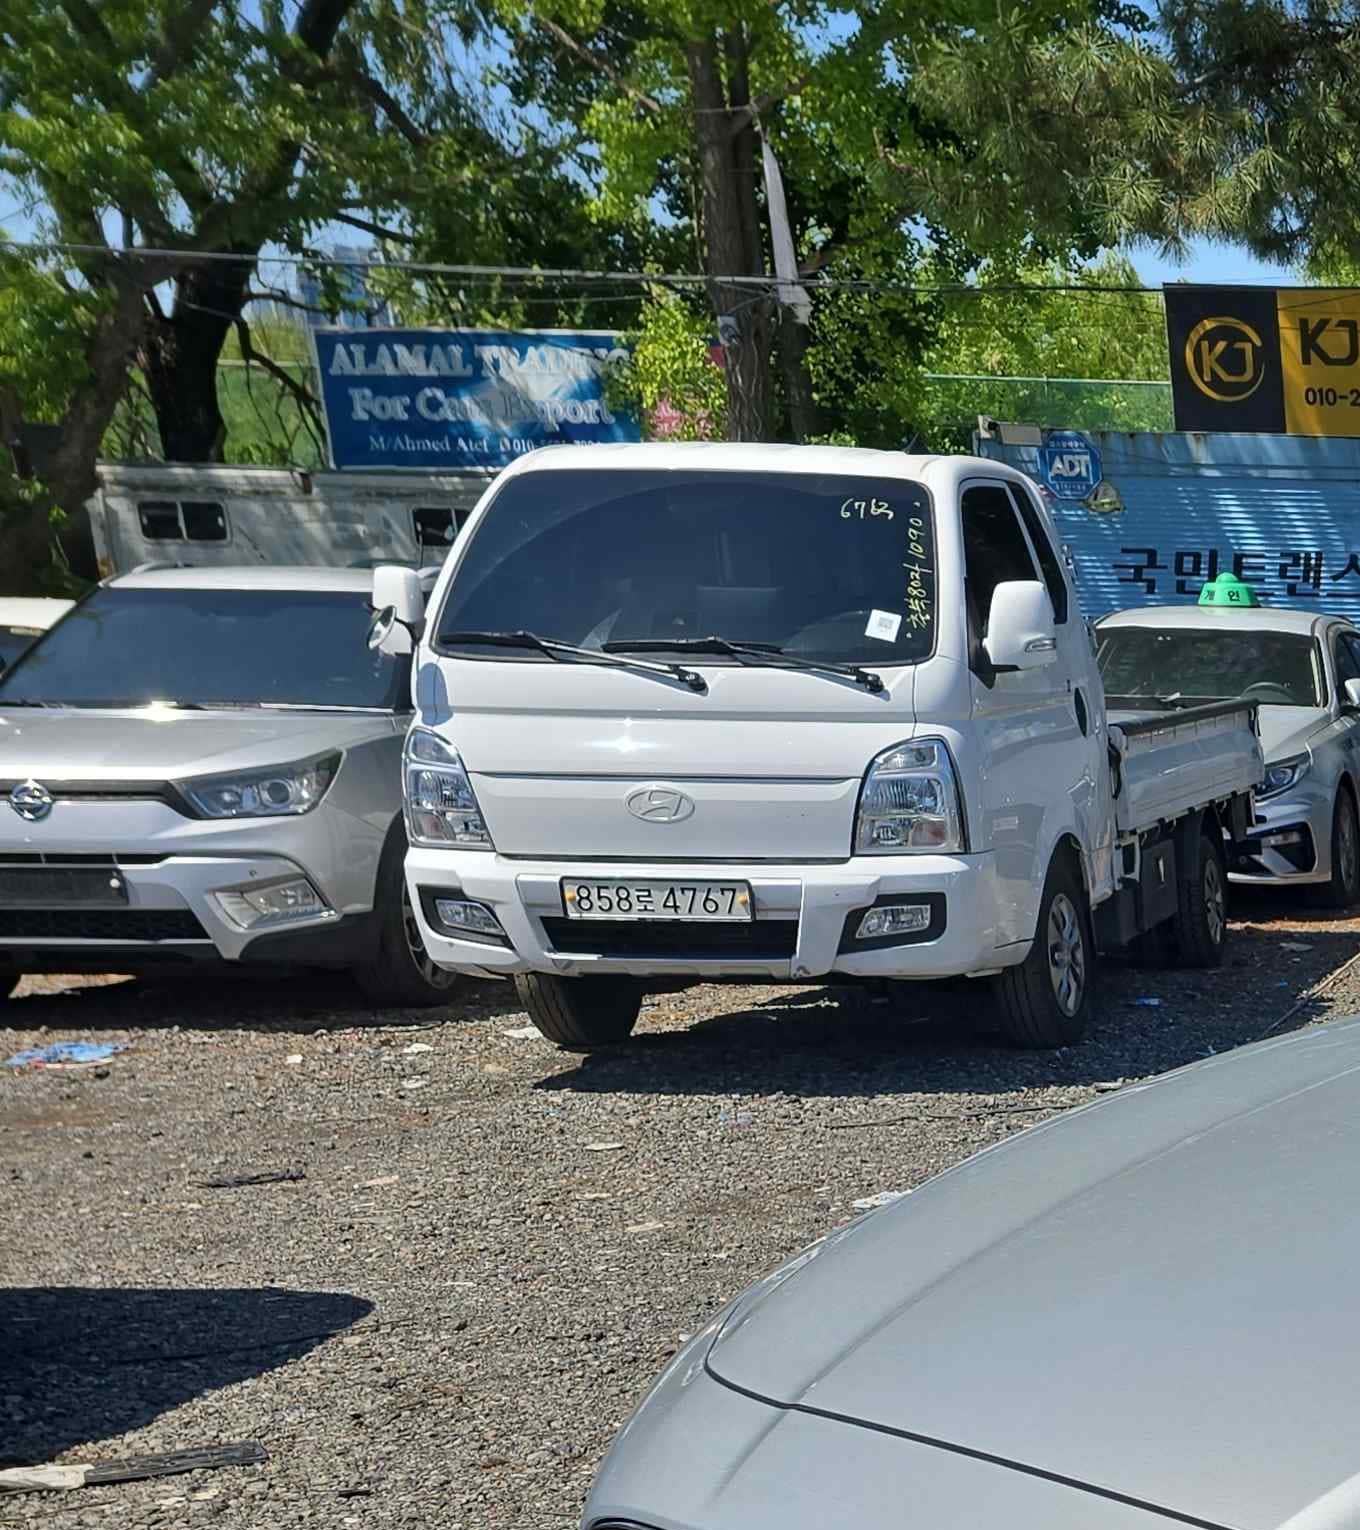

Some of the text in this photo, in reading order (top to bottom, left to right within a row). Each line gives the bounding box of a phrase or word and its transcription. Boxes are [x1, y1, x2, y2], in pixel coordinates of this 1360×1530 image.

[1298, 317, 1360, 367] KJ
[329, 343, 473, 378] ALAMAL
[348, 386, 411, 422] For
[1051, 453, 1090, 478] ADT
[576, 885, 738, 915] 858로 4767
